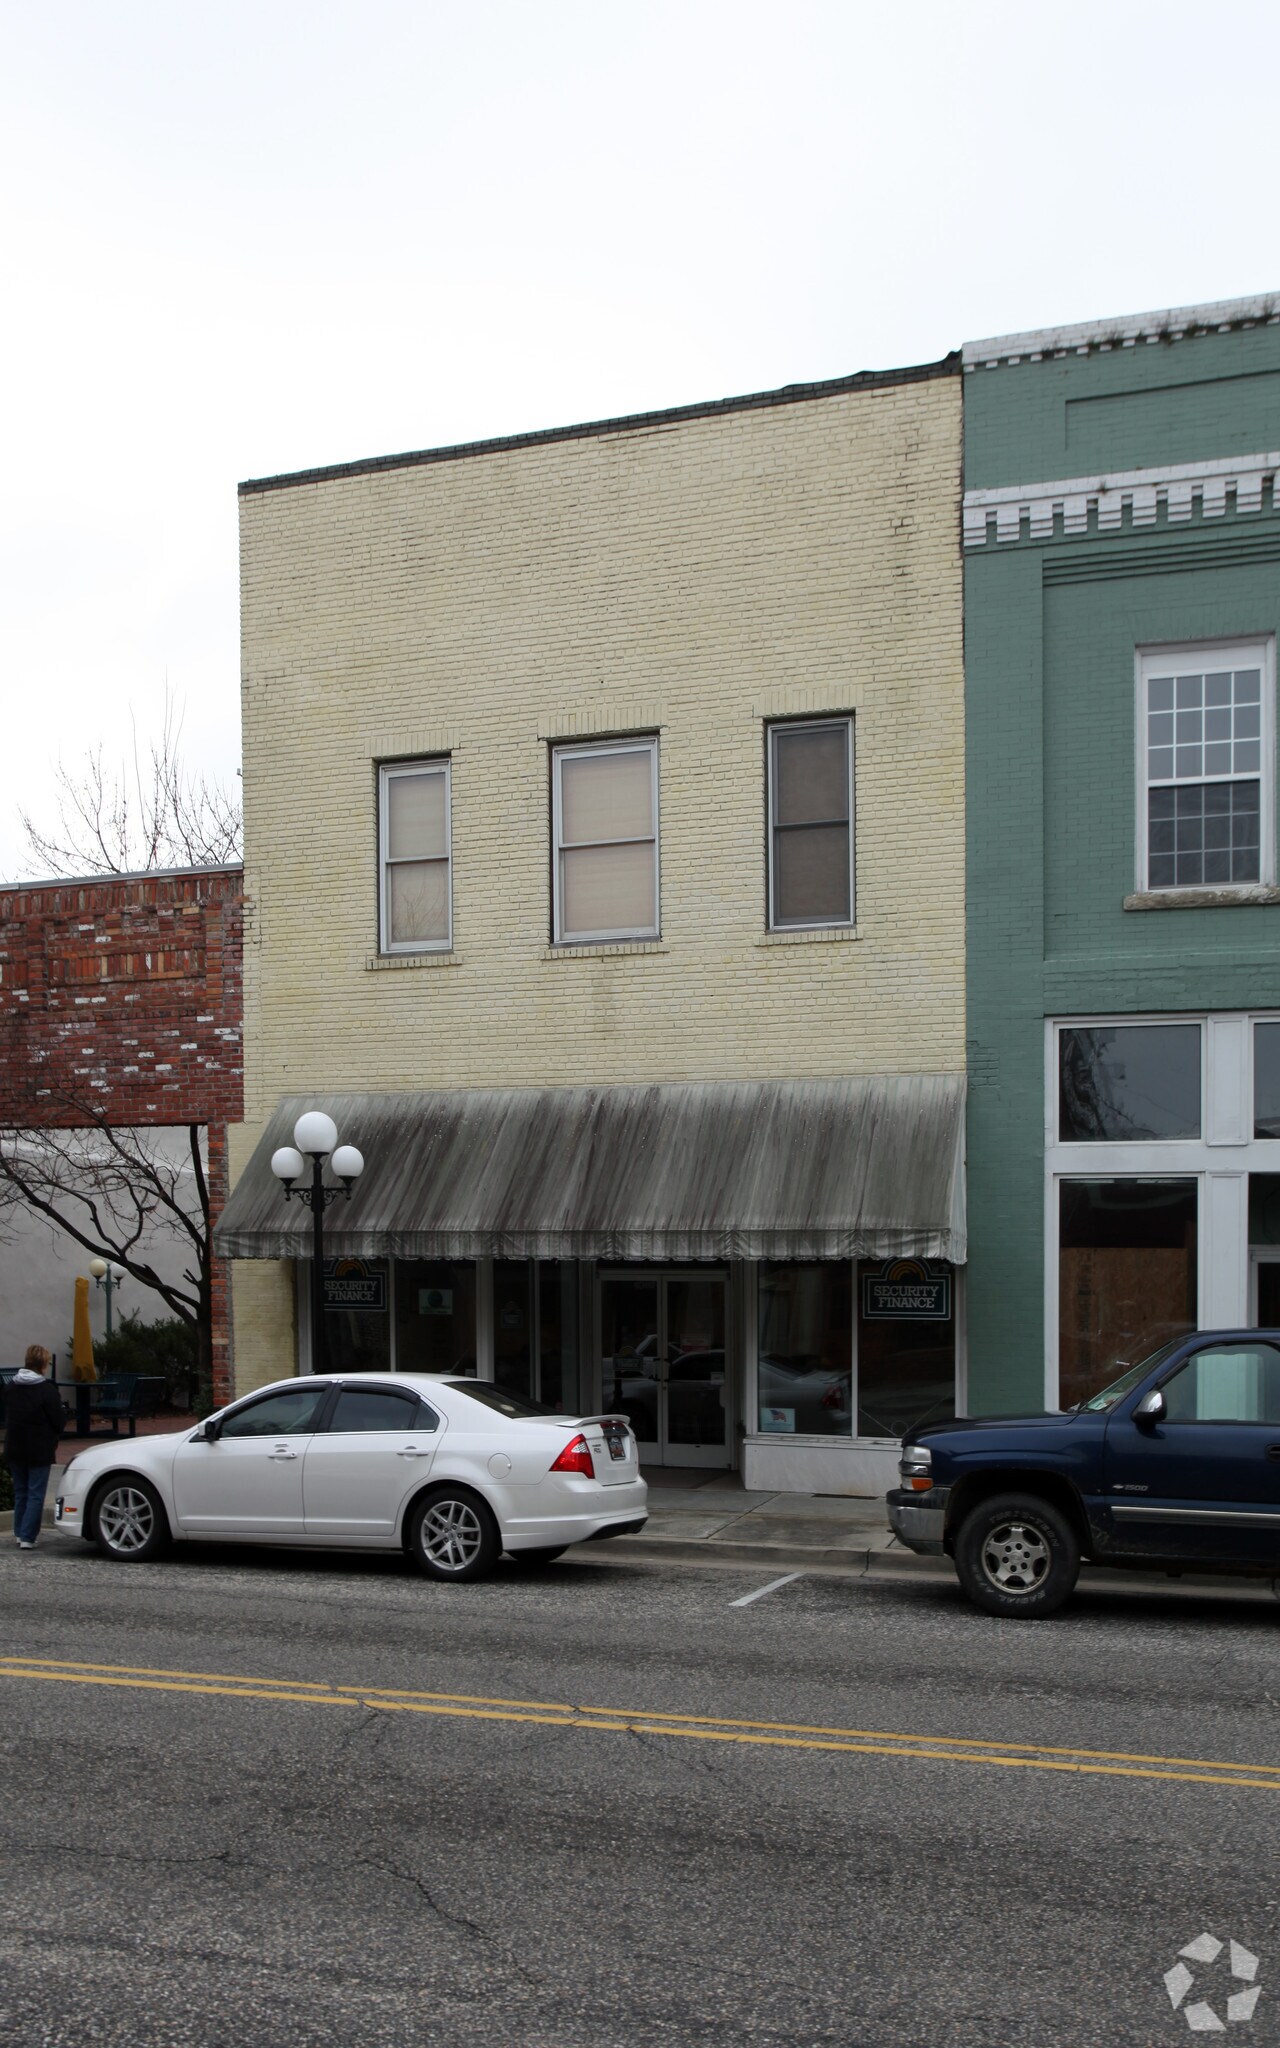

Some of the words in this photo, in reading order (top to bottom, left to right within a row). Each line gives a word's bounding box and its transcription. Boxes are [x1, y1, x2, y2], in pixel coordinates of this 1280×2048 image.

[324, 1281, 378, 1291] SECURITY
[873, 1285, 939, 1297] SECURITY
[328, 1290, 375, 1301] FINANCE
[878, 1297, 935, 1308] FINANCE
